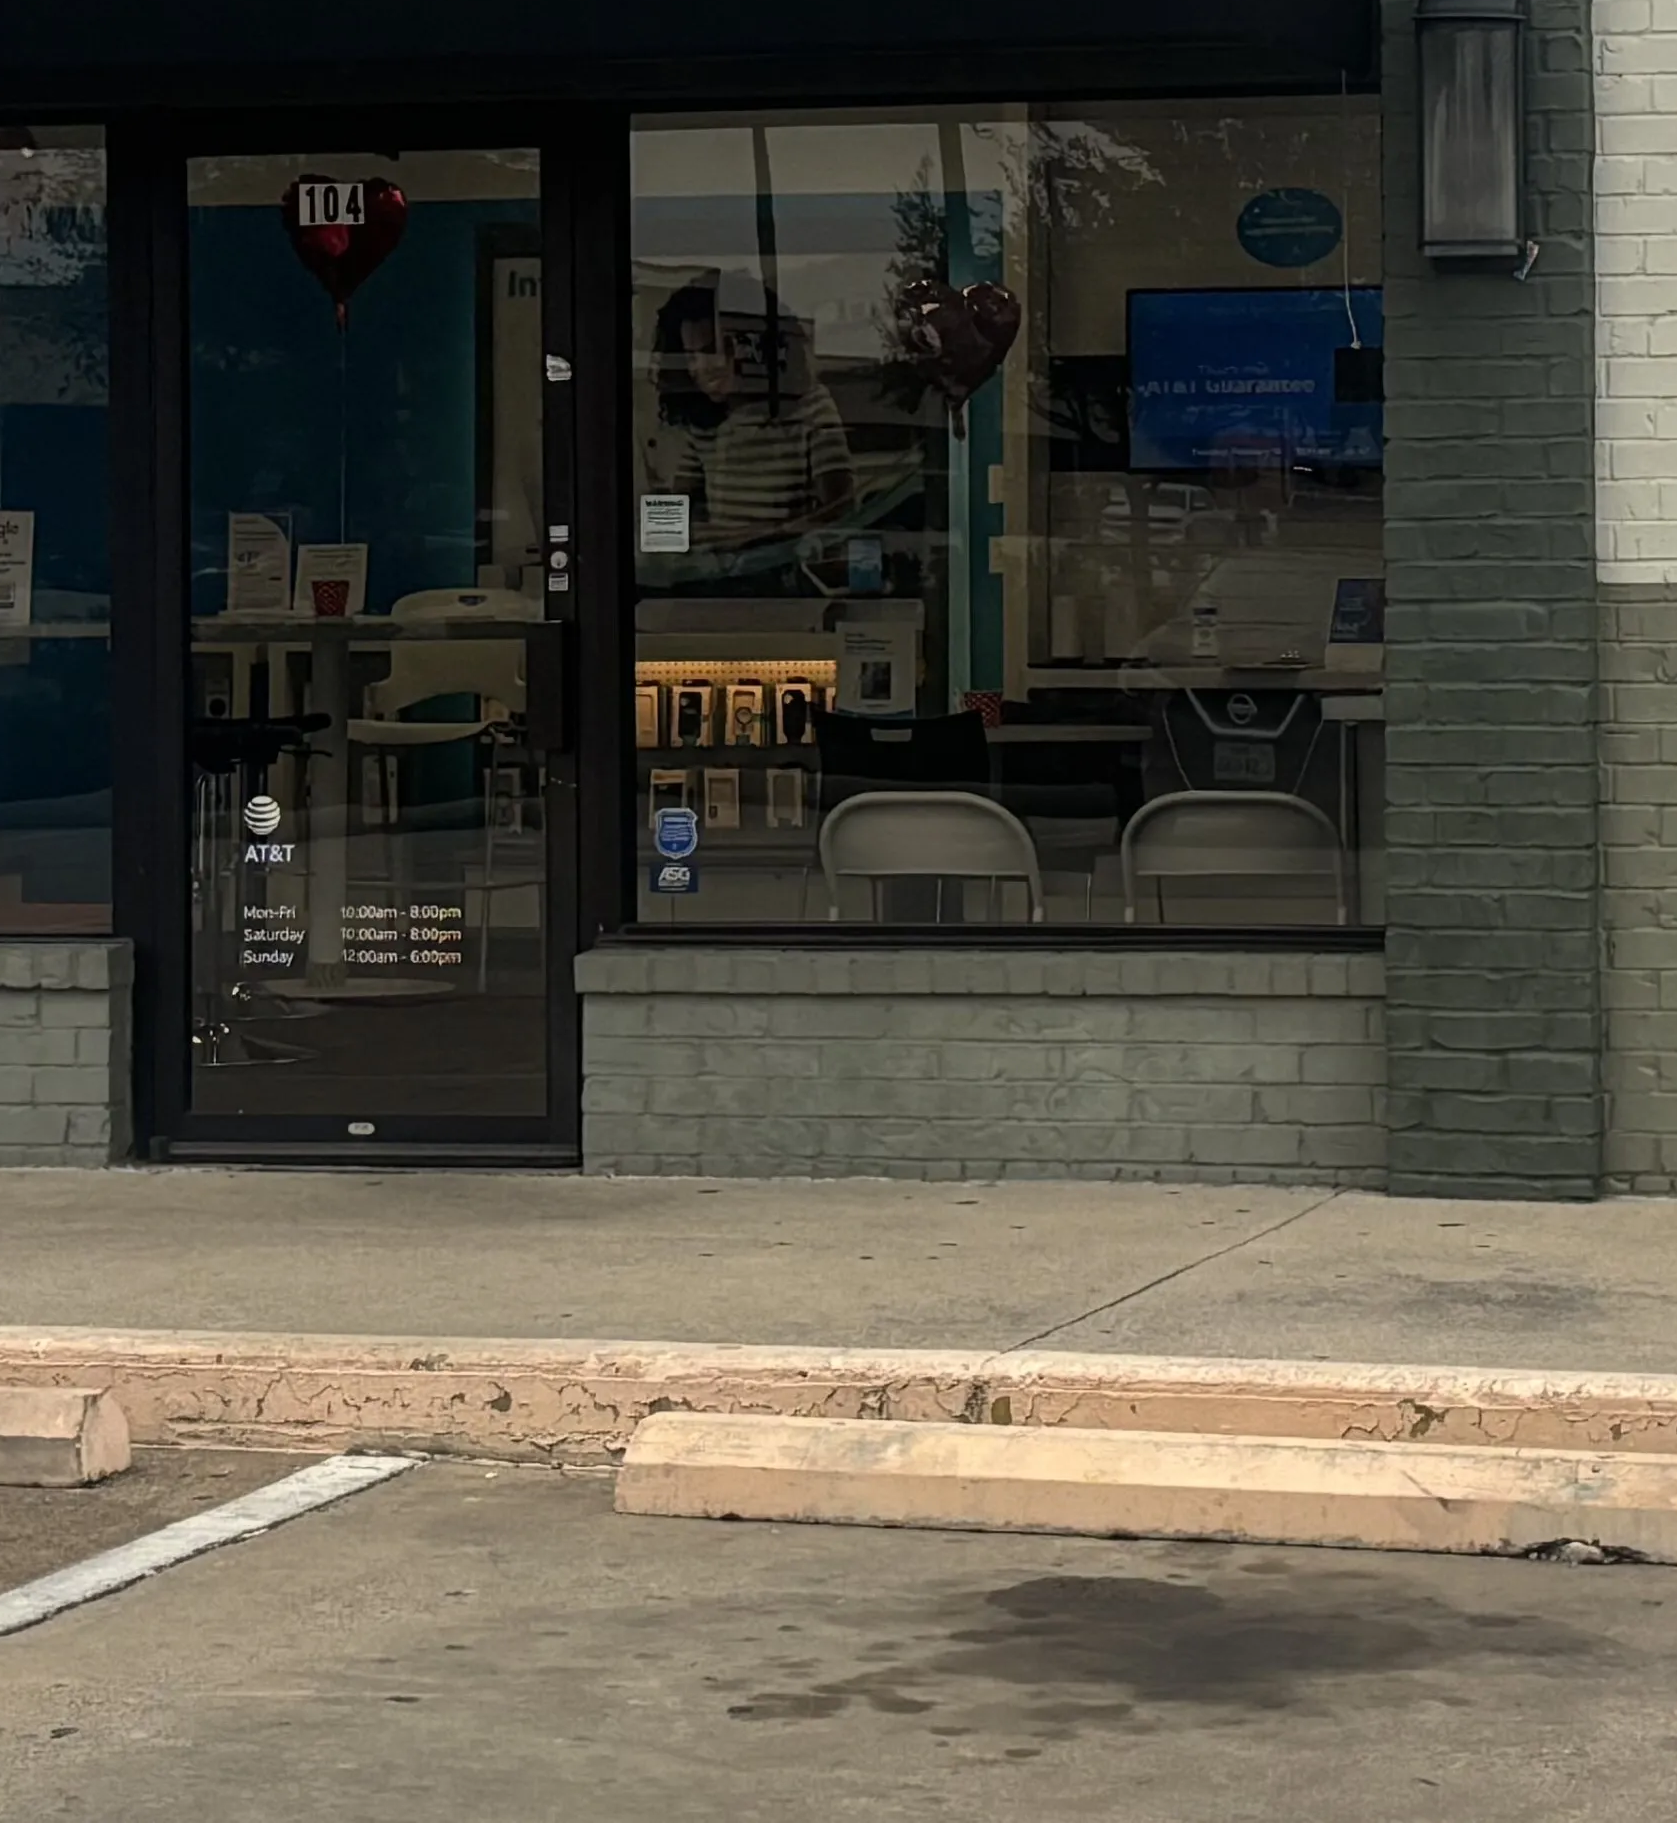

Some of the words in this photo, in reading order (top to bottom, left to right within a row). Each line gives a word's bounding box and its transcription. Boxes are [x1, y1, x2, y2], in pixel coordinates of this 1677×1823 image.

[306, 185, 361, 223] 104
[244, 844, 296, 863] AT&T
[244, 905, 296, 919] Mon-Fri
[340, 905, 397, 919] 10:00am
[410, 905, 462, 921] 8:00pm
[244, 926, 305, 944] Saturday
[340, 927, 398, 941] 10:00am
[410, 926, 462, 944] 8:00pm
[244, 949, 294, 967] Sunday
[342, 948, 398, 963] 12:00am
[410, 949, 462, 966] 6:00pm
